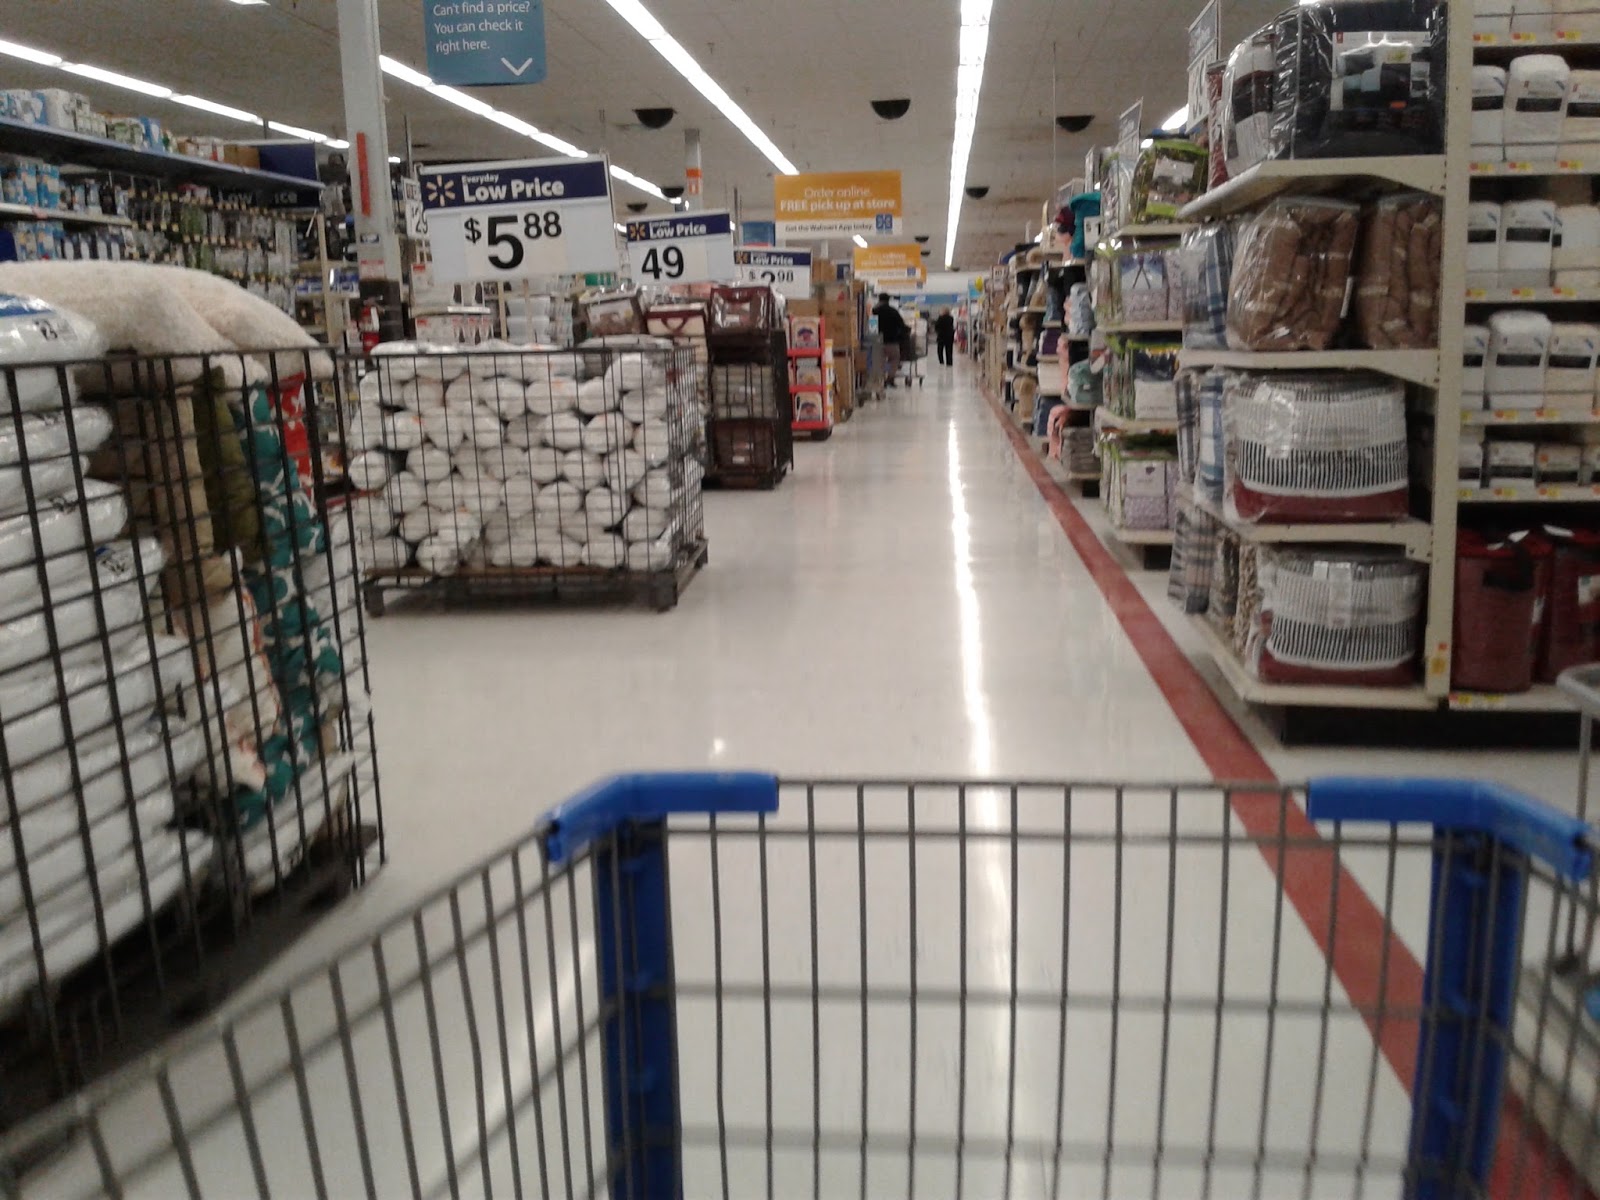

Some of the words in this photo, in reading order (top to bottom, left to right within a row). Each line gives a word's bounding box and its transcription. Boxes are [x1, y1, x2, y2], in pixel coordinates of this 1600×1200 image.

[433, 3, 459, 17] Can't
[462, 2, 484, 14] find
[487, 4, 494, 13] a
[497, 1, 530, 15] price?
[434, 23, 454, 34] You
[457, 22, 475, 32] can
[479, 19, 512, 32] check
[515, 19, 523, 31] it
[435, 40, 460, 55] right
[463, 38, 490, 50] here.
[461, 173, 499, 184] Everyday
[462, 181, 507, 203] Low
[511, 177, 564, 199] Price
[804, 187, 834, 198] Order
[780, 200, 807, 212] FREE
[810, 199, 833, 213] pick
[836, 200, 851, 211] up
[853, 199, 864, 209] at
[649, 223, 674, 239] Low
[676, 221, 706, 237] Price
[641, 246, 684, 279] 49
